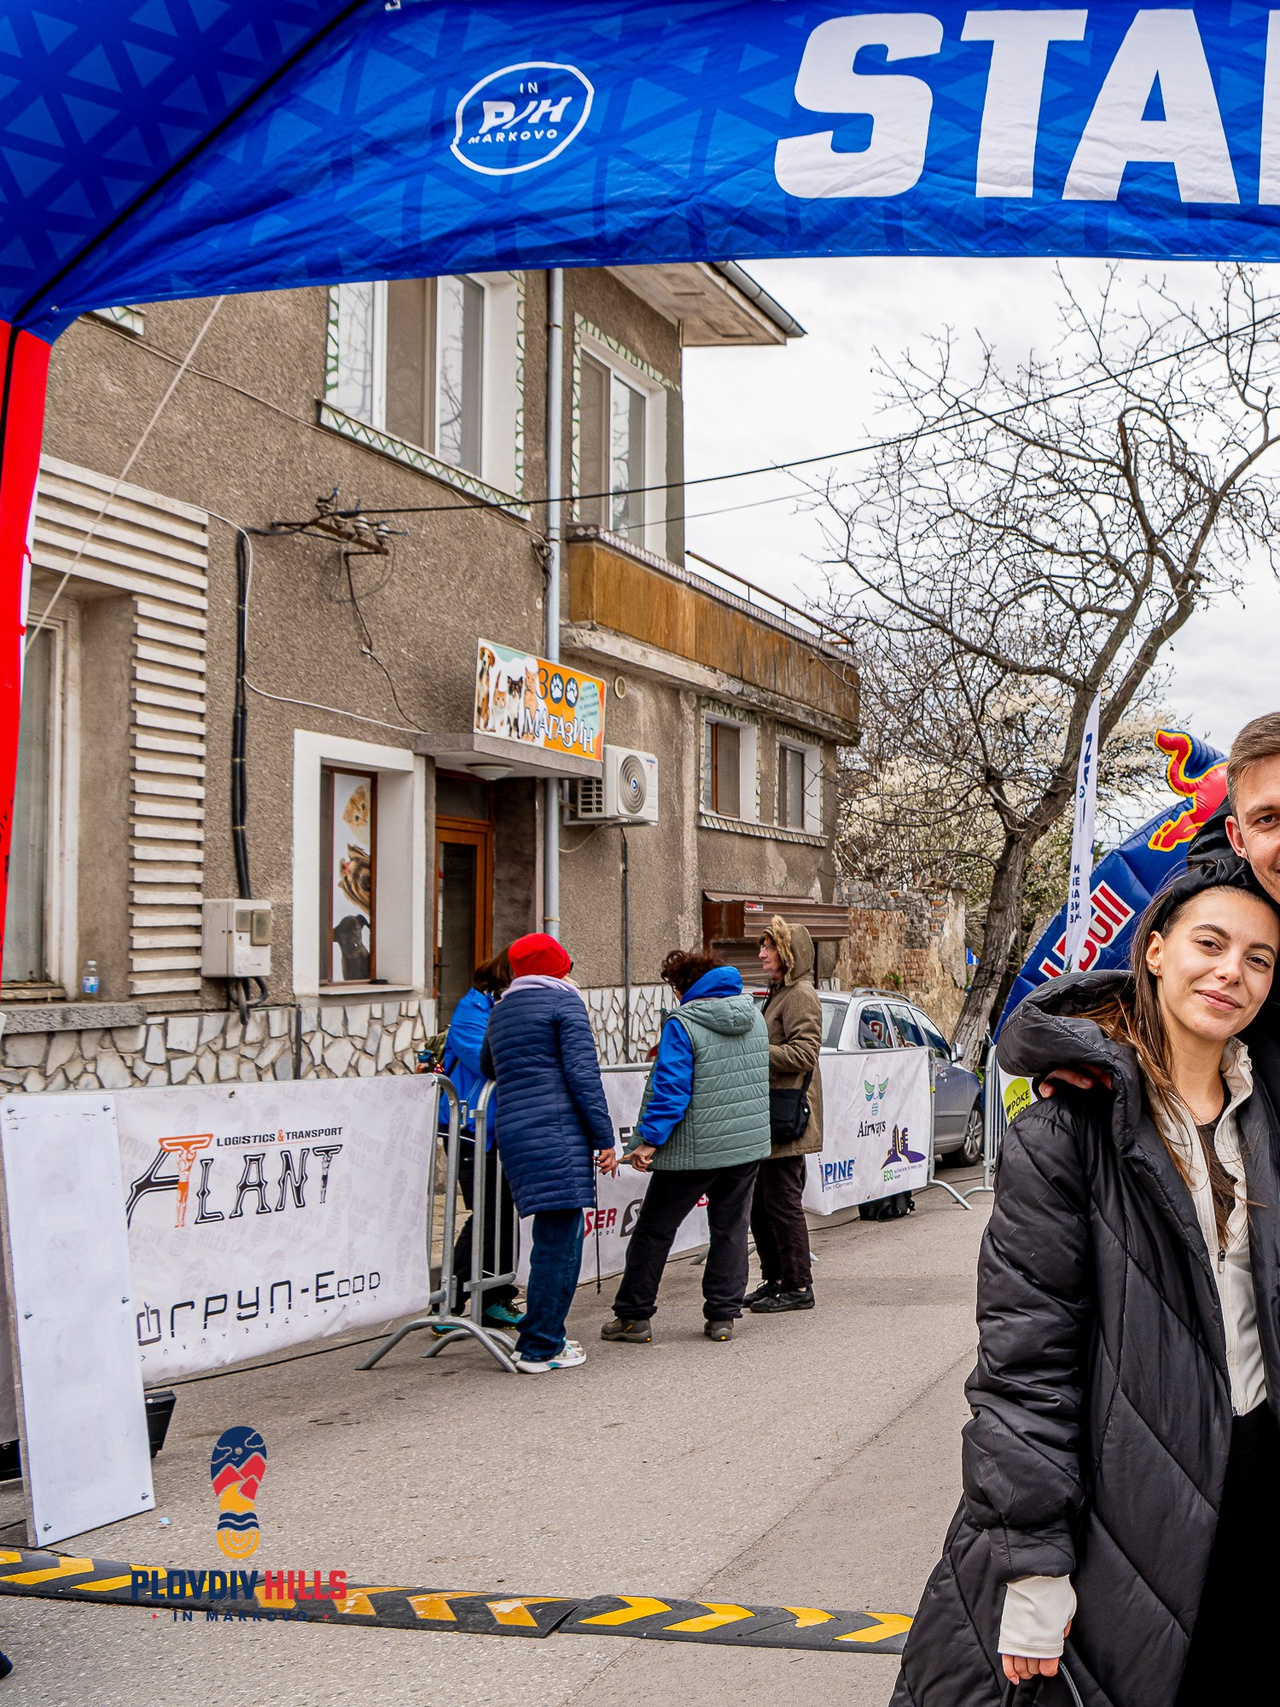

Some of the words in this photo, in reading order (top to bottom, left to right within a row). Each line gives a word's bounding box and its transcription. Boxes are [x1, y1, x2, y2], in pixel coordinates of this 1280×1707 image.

[519, 82, 538, 94] IN
[467, 129, 558, 145] MARKOVO
[523, 707, 594, 753] МАГАЗИН
[1011, 1089, 1030, 1110] POKE
[216, 1133, 276, 1147] LOGISTICS
[285, 1127, 343, 1140] TRANSPORT
[857, 1120, 886, 1138] Airways
